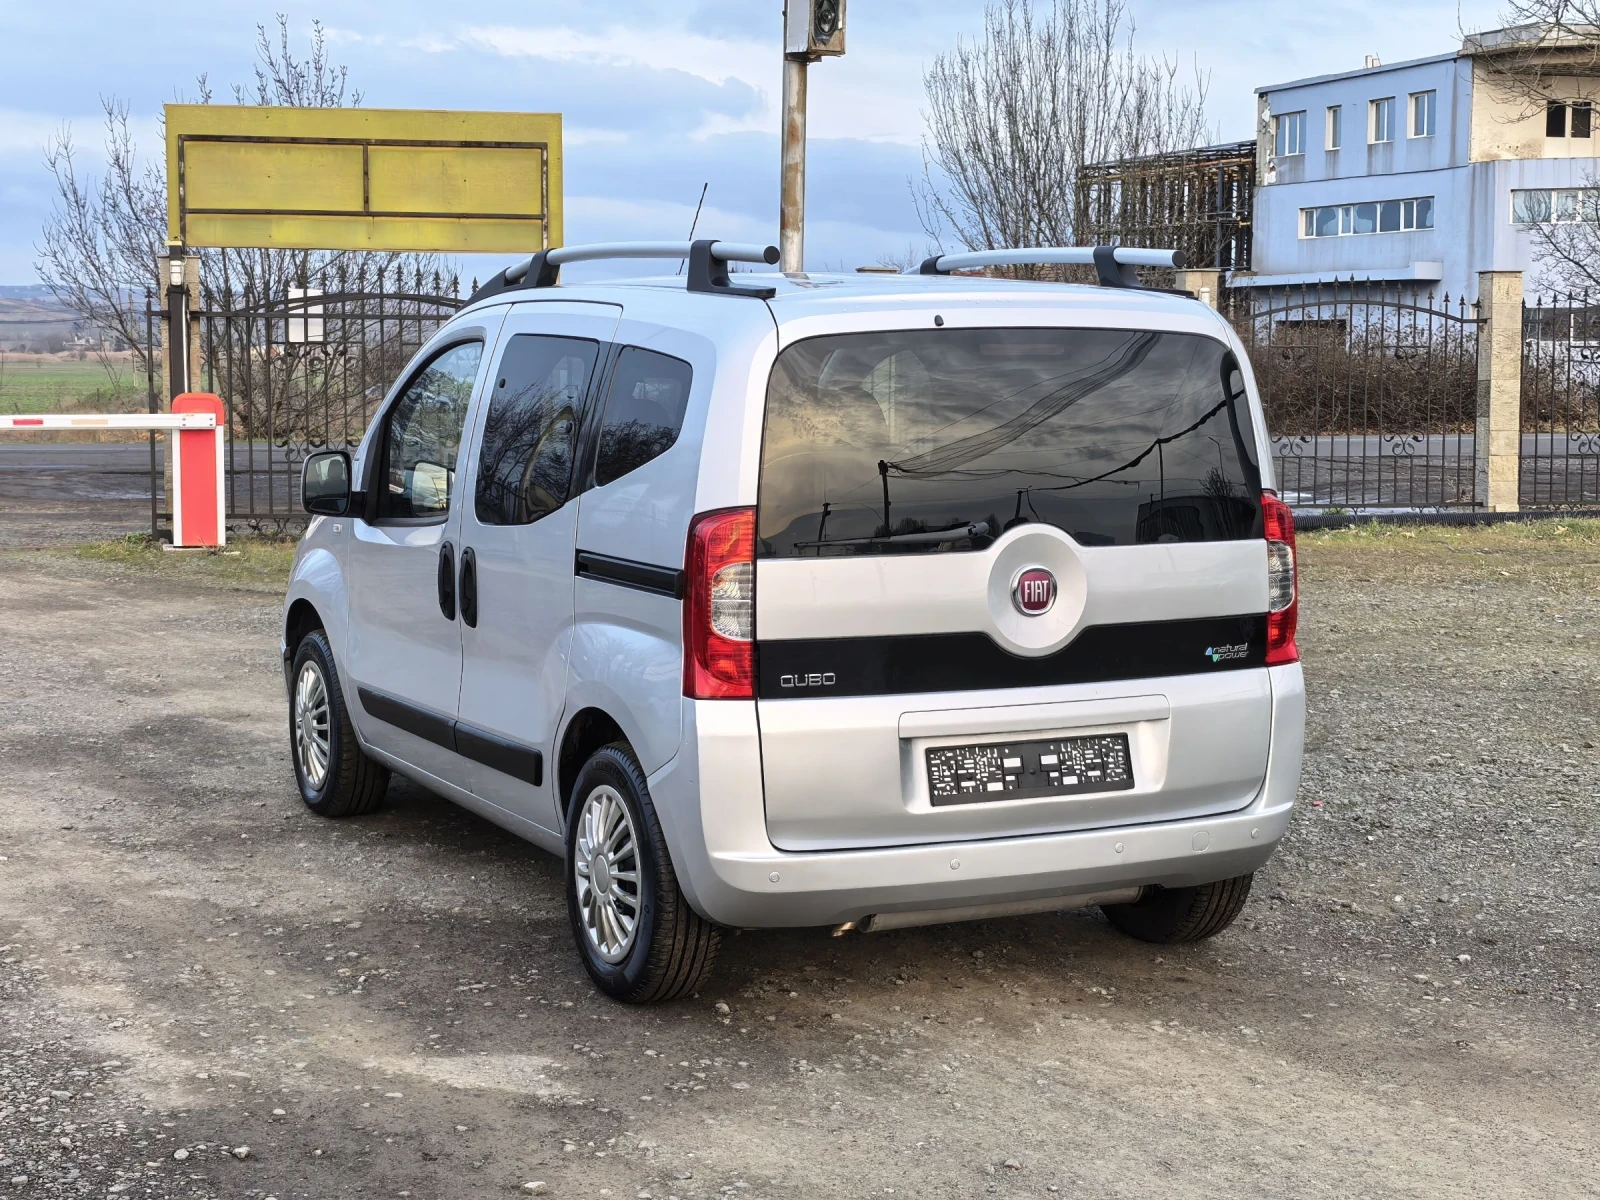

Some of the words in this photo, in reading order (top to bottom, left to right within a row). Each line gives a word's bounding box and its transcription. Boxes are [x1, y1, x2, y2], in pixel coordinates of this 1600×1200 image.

[1024, 580, 1049, 603] FIAT
[1213, 642, 1248, 653] natural
[1217, 651, 1249, 662] power
[780, 672, 836, 688] QUBO
